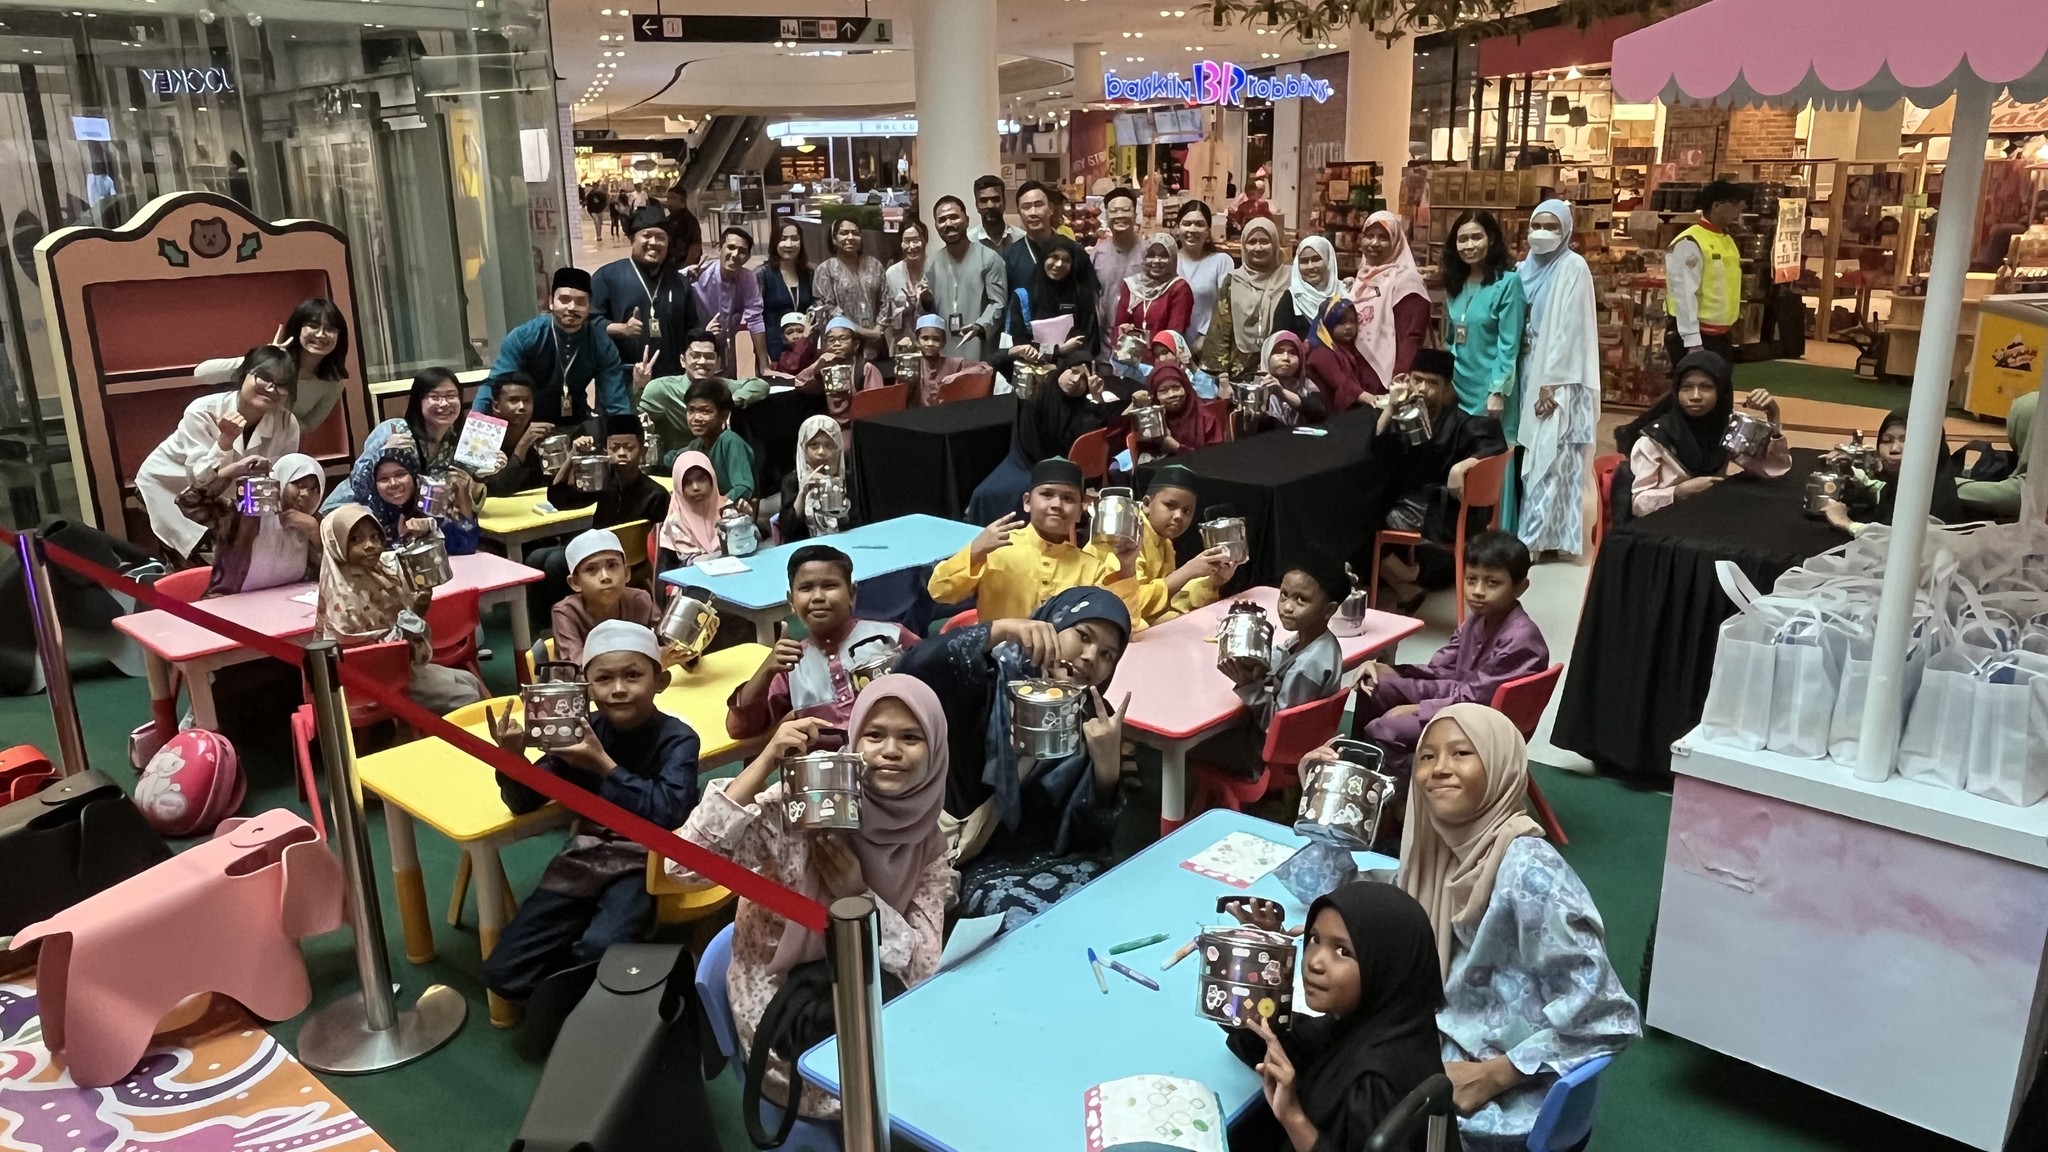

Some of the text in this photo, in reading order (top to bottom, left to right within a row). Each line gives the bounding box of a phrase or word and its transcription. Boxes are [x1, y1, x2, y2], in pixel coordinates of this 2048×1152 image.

[1104, 60, 1329, 106] baskin BR robbins
